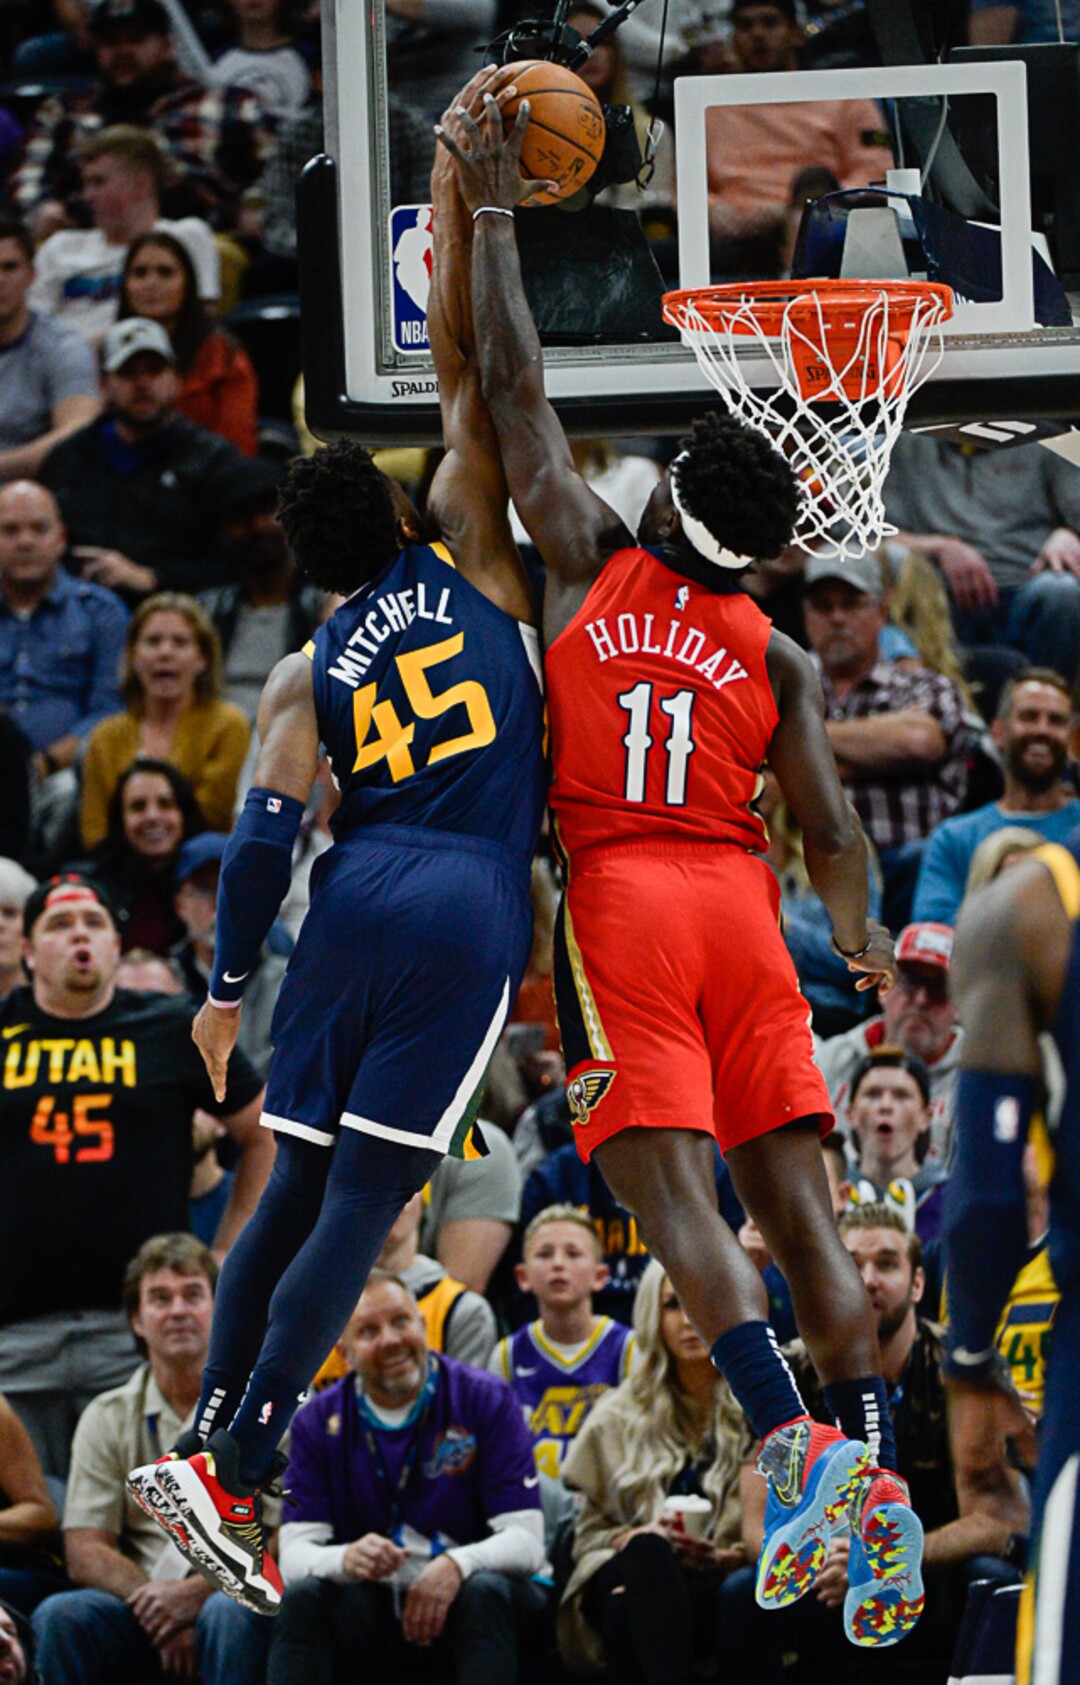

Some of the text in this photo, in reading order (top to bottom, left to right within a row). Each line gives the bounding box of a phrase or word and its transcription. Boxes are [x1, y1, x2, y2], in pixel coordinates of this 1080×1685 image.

[401, 320, 430, 344] NBA
[327, 582, 453, 688] MITCHELL
[585, 613, 749, 690] HOLIDAY
[352, 631, 497, 783] 45
[617, 681, 697, 806] 11
[3, 1037, 137, 1089] UTAH
[30, 1093, 114, 1163] 45
